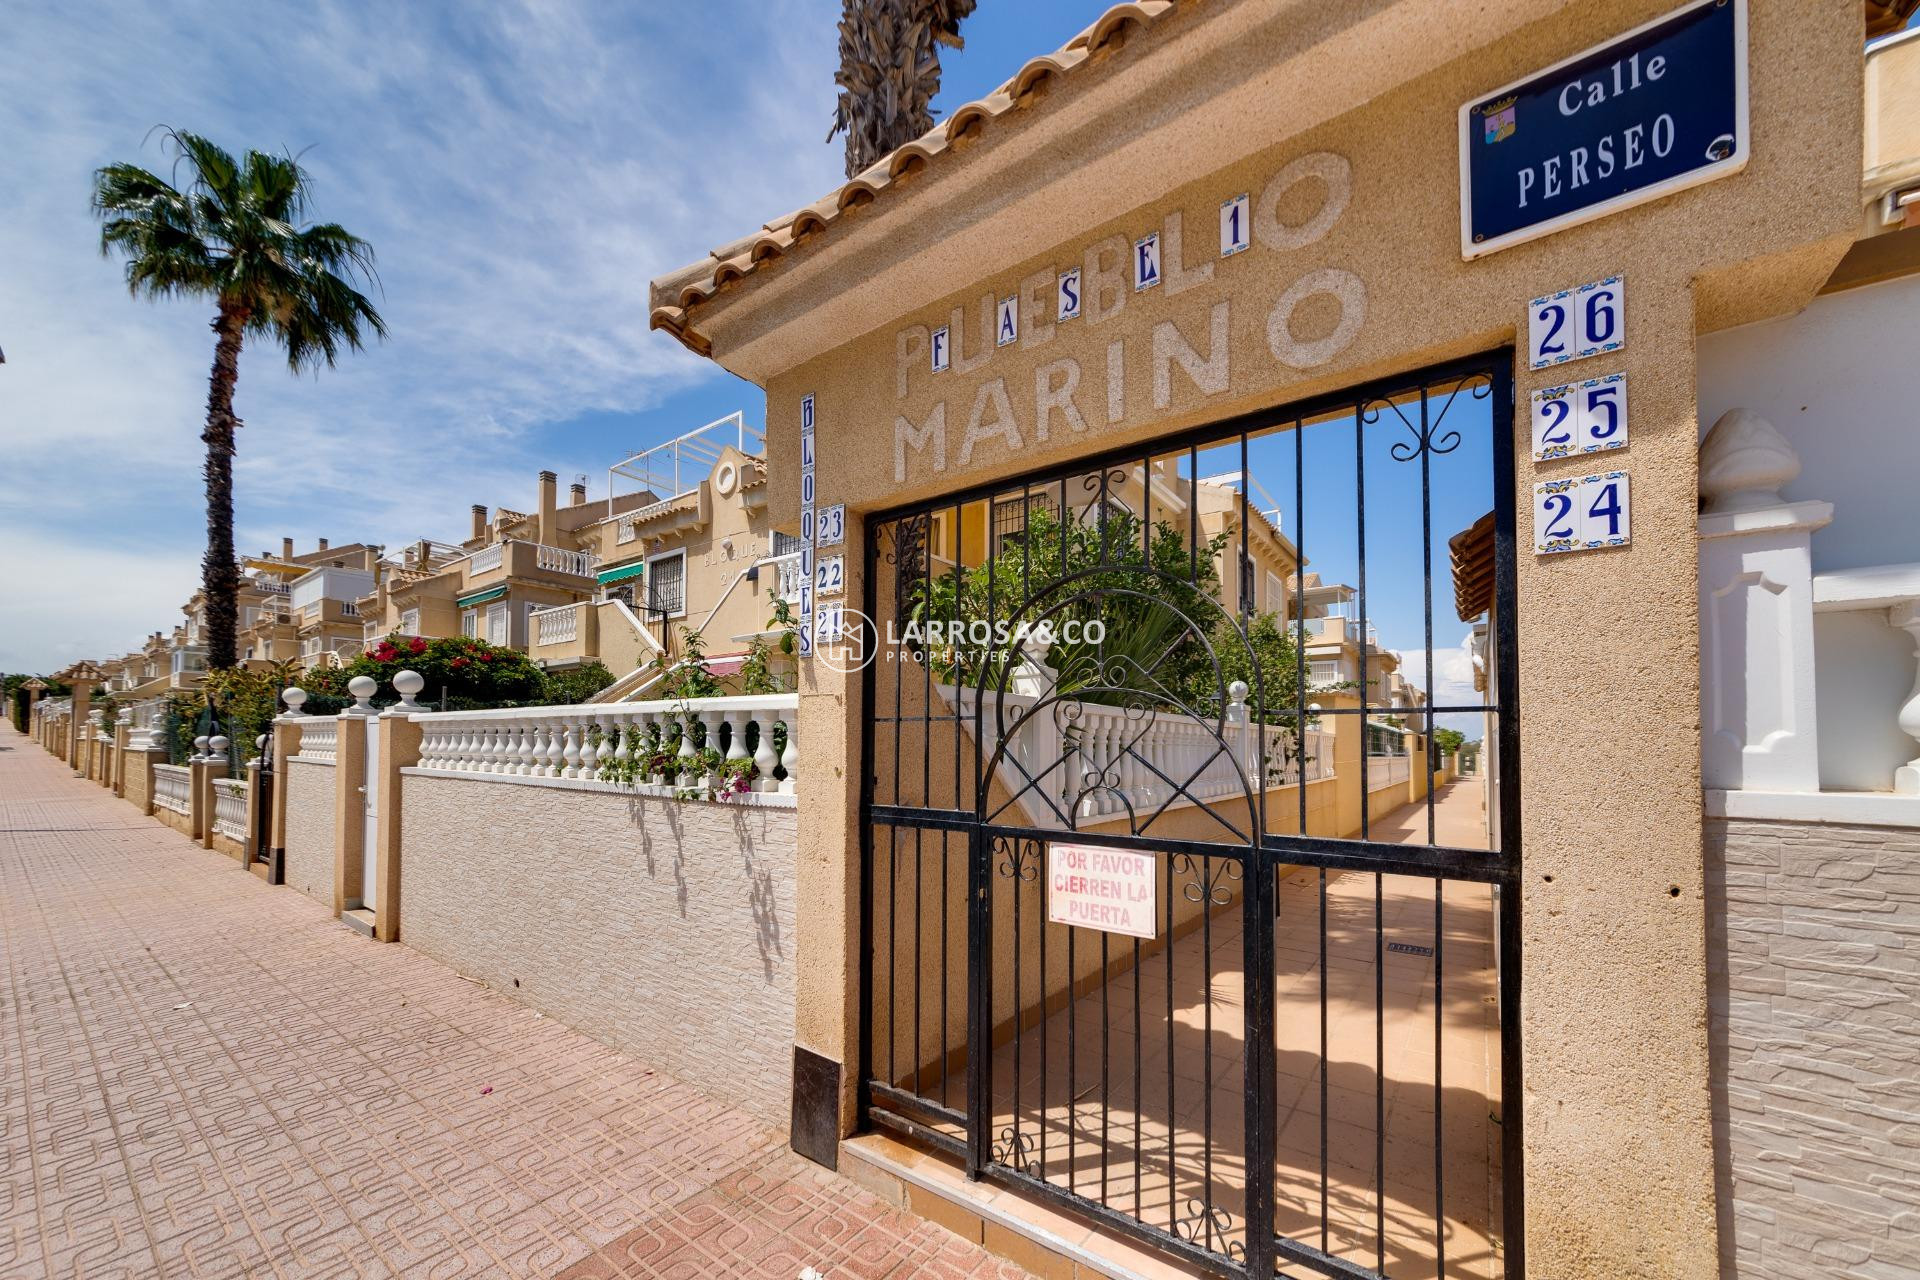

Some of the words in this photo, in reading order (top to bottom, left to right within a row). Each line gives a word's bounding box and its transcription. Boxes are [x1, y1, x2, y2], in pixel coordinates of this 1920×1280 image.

[1558, 52, 1667, 117] Calle
[1517, 113, 1676, 209] PERSEO
[896, 150, 1352, 399] PUEBLO
[1538, 289, 1616, 357] 26
[894, 267, 1368, 483] MARINO
[1540, 386, 1619, 445] 25
[800, 397, 813, 653] BLOQUES
[818, 510, 842, 541] 23
[1543, 482, 1622, 539] 24
[817, 562, 841, 589] 22
[817, 611, 839, 635] 21
[1054, 873, 1121, 900] CIERREN
[1127, 883, 1148, 903] LA
[1057, 849, 1088, 871] POR
[1092, 853, 1146, 877] FAVOR
[1069, 900, 1132, 928] PUERTA
